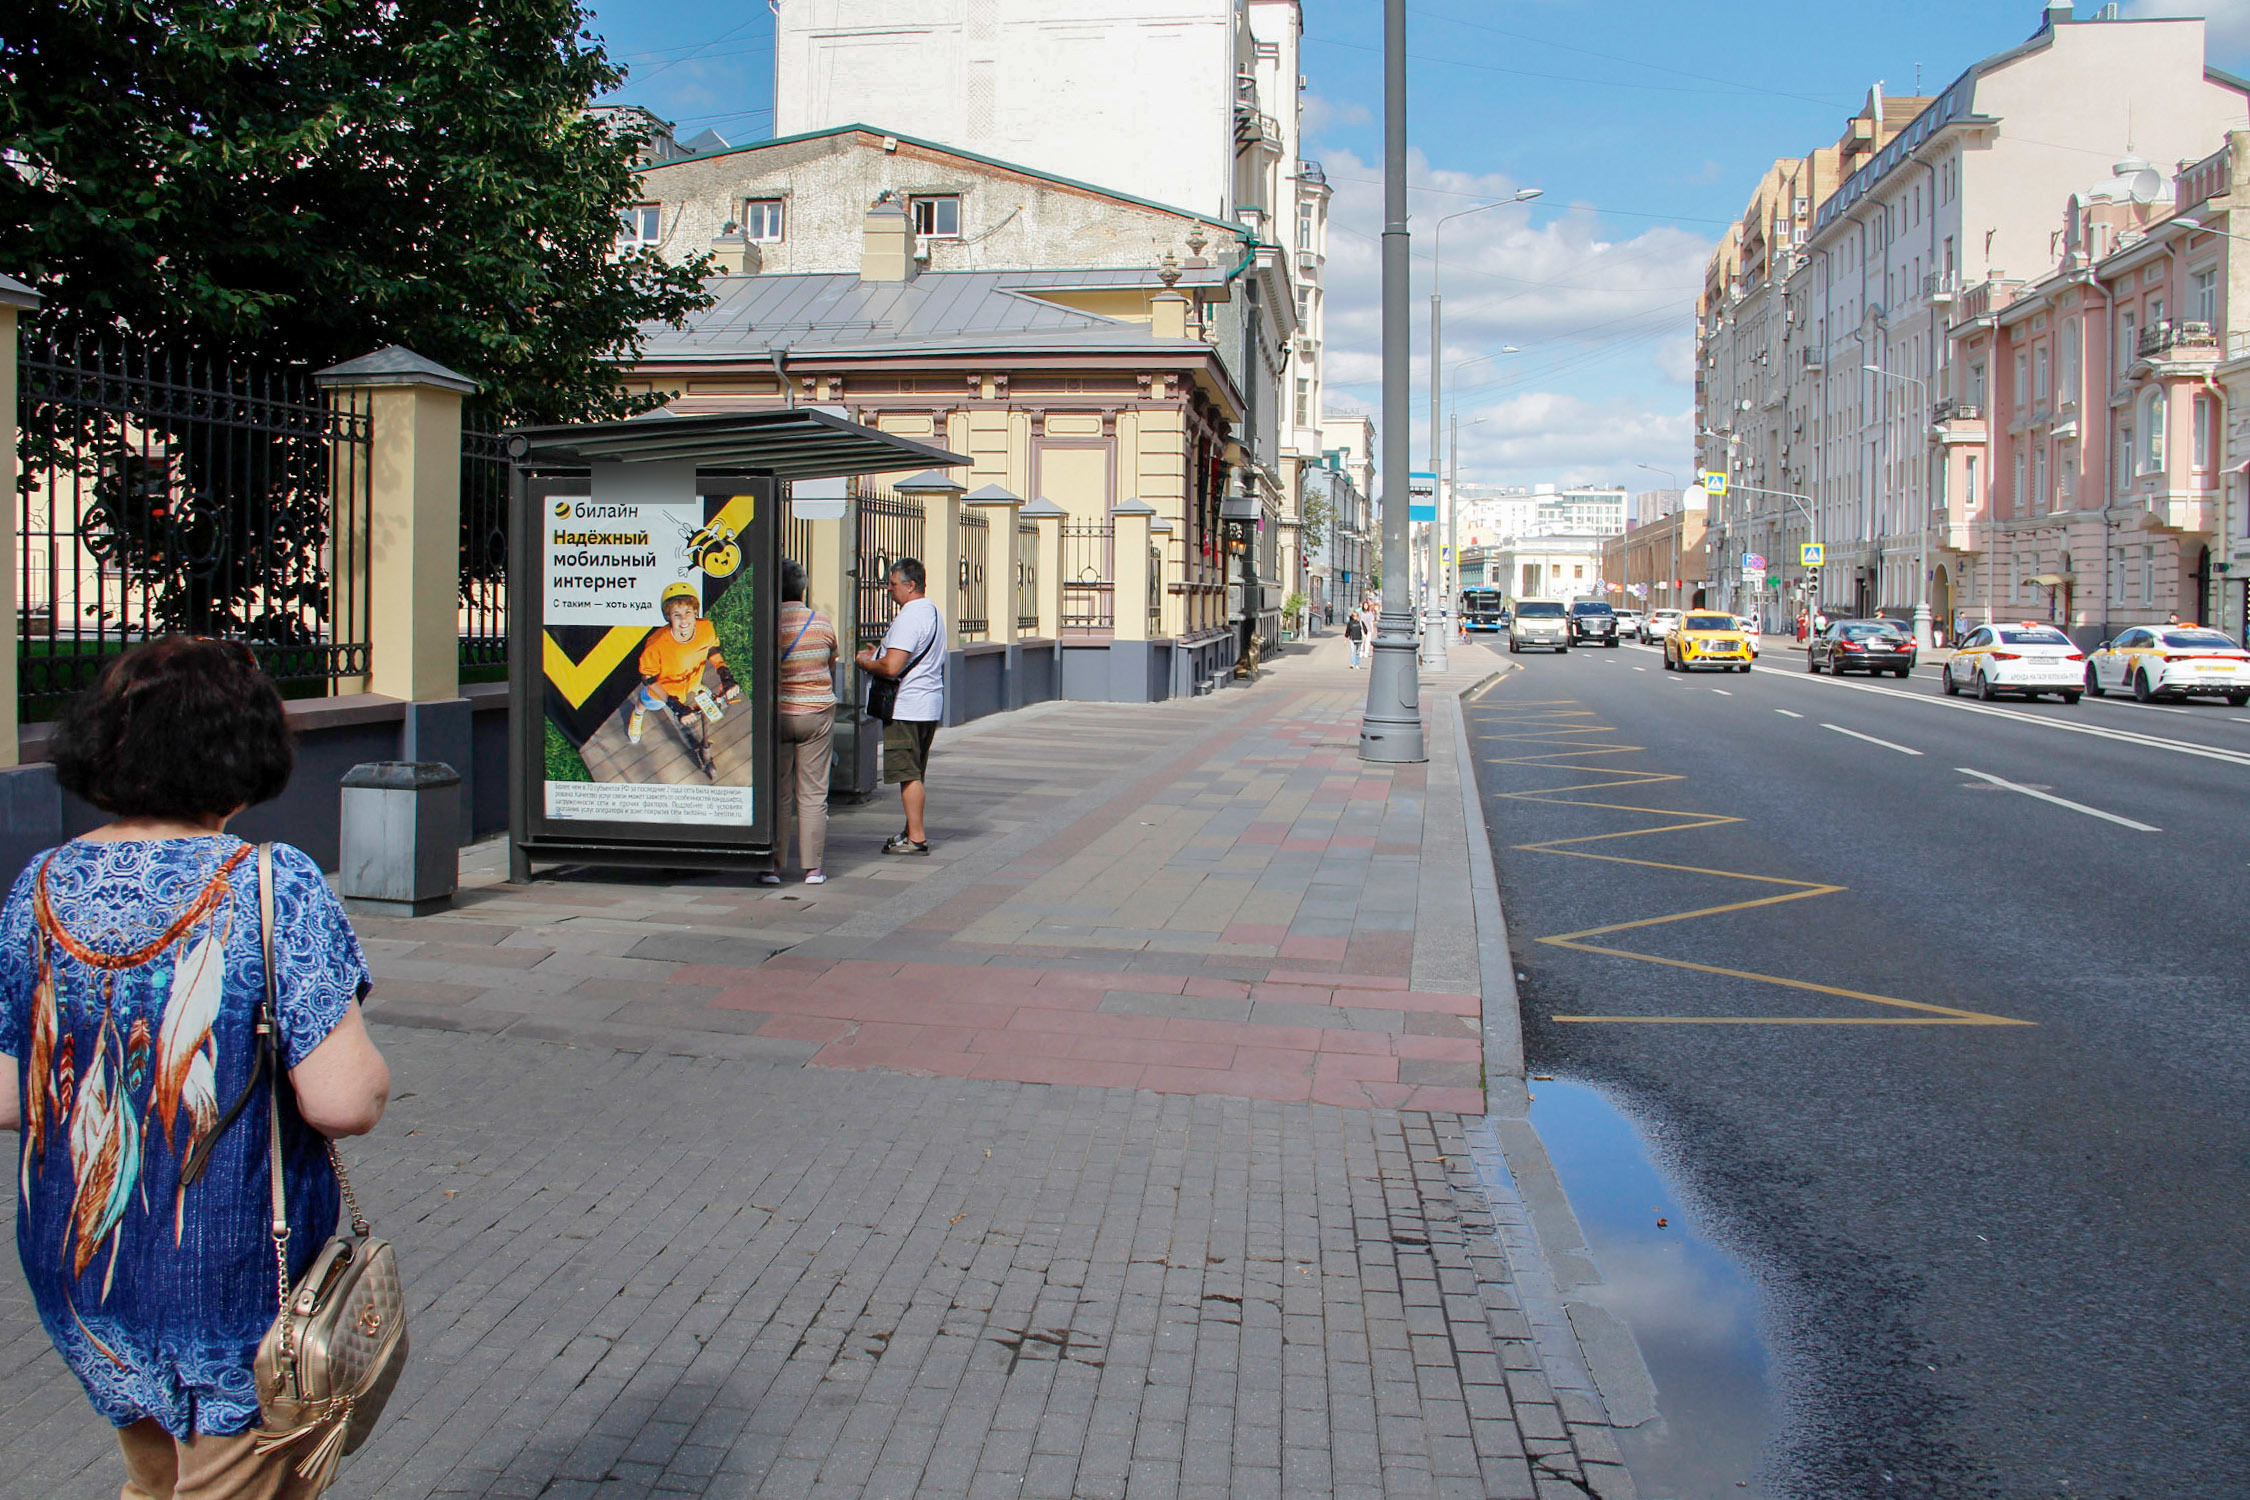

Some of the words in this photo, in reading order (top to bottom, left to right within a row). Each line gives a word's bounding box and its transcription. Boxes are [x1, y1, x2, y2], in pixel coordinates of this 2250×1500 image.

[575, 502, 638, 518] билайн
[554, 529, 649, 547] Надёжный
[554, 551, 656, 567] мобильный
[554, 575, 637, 592] интернет
[554, 599, 560, 608] С
[562, 600, 592, 608] таким
[630, 602, 652, 610] куда
